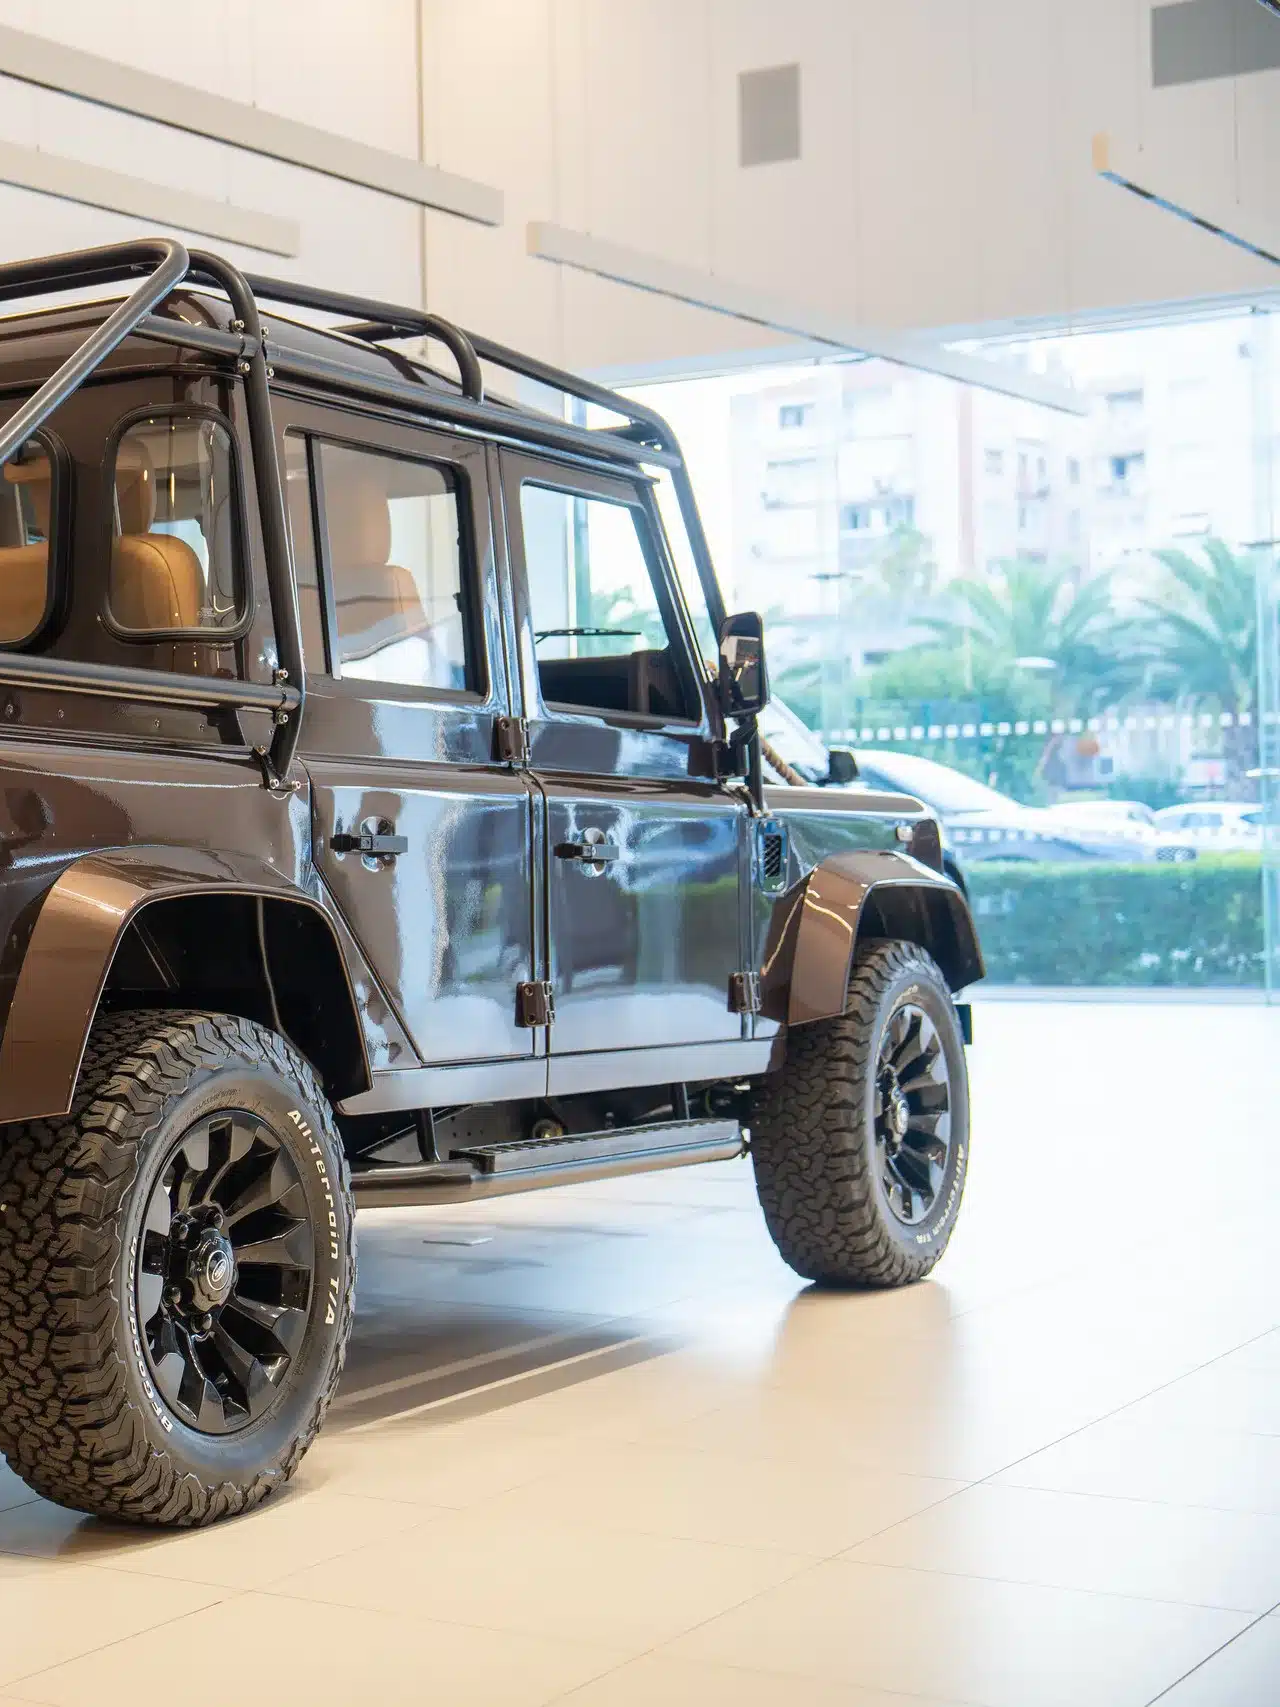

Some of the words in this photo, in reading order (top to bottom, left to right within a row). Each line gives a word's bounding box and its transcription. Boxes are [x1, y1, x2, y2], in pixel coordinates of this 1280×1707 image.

[287, 1109, 340, 1260] All-Terrain
[324, 1276, 340, 1325] T/A
[127, 1236, 173, 1433] BFGoodrich
